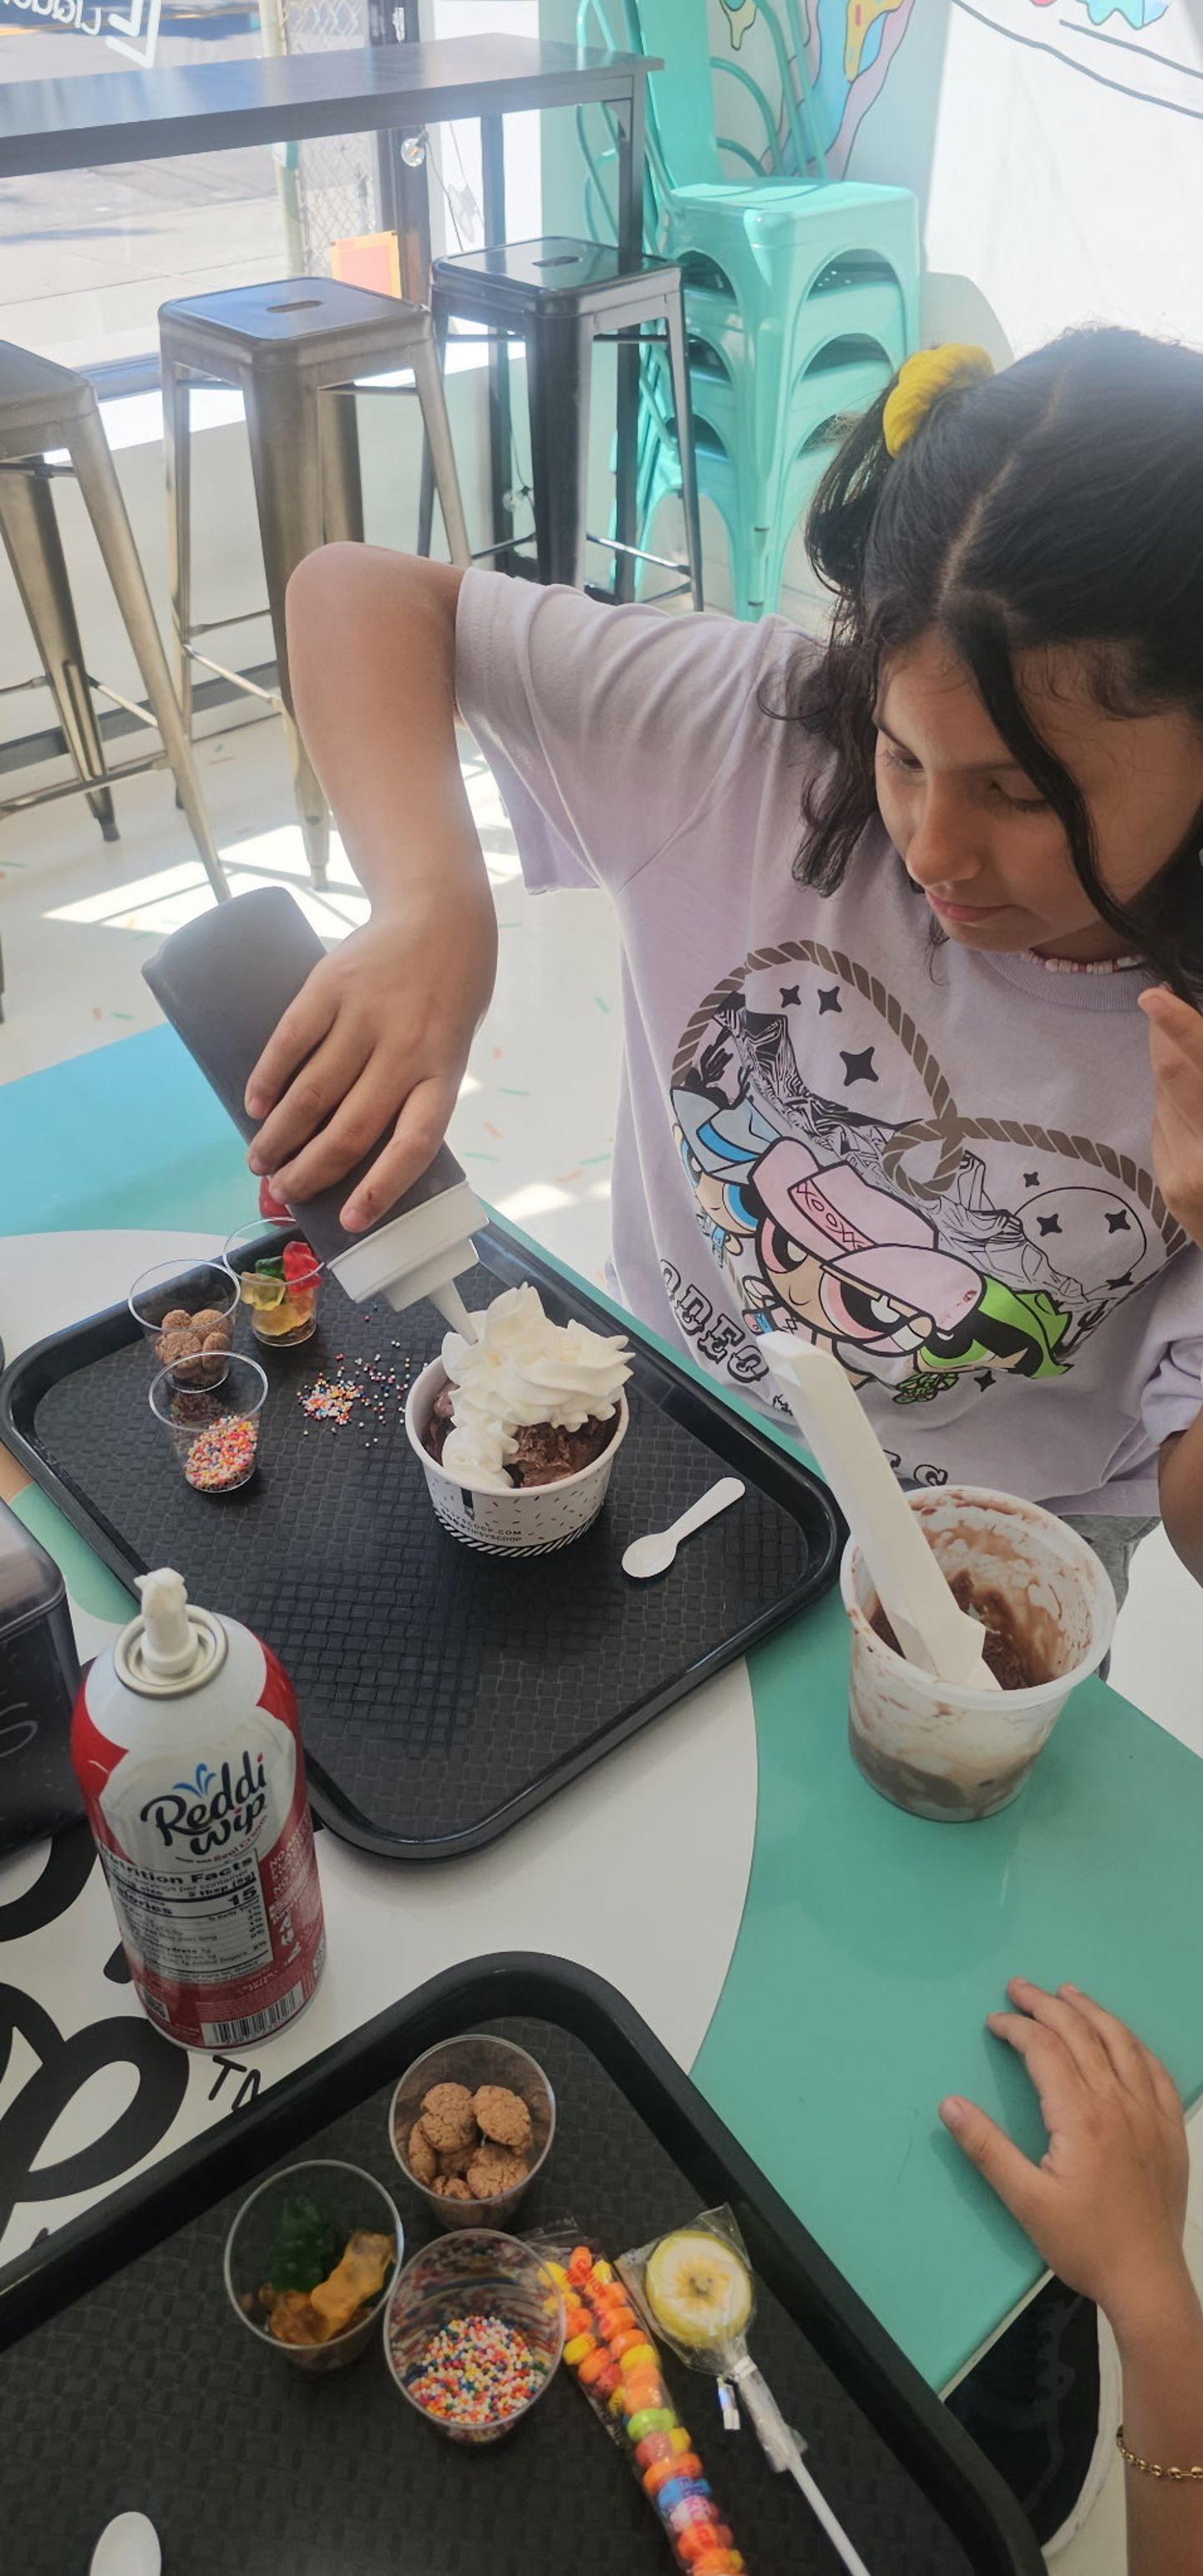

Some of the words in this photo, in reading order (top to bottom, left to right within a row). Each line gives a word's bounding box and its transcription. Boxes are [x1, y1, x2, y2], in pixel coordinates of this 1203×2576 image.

[140, 1751, 266, 1847] Reddi
[190, 1793, 266, 1856] wip
[191, 1857, 252, 1883] Facts
[228, 1885, 257, 1906] 15
